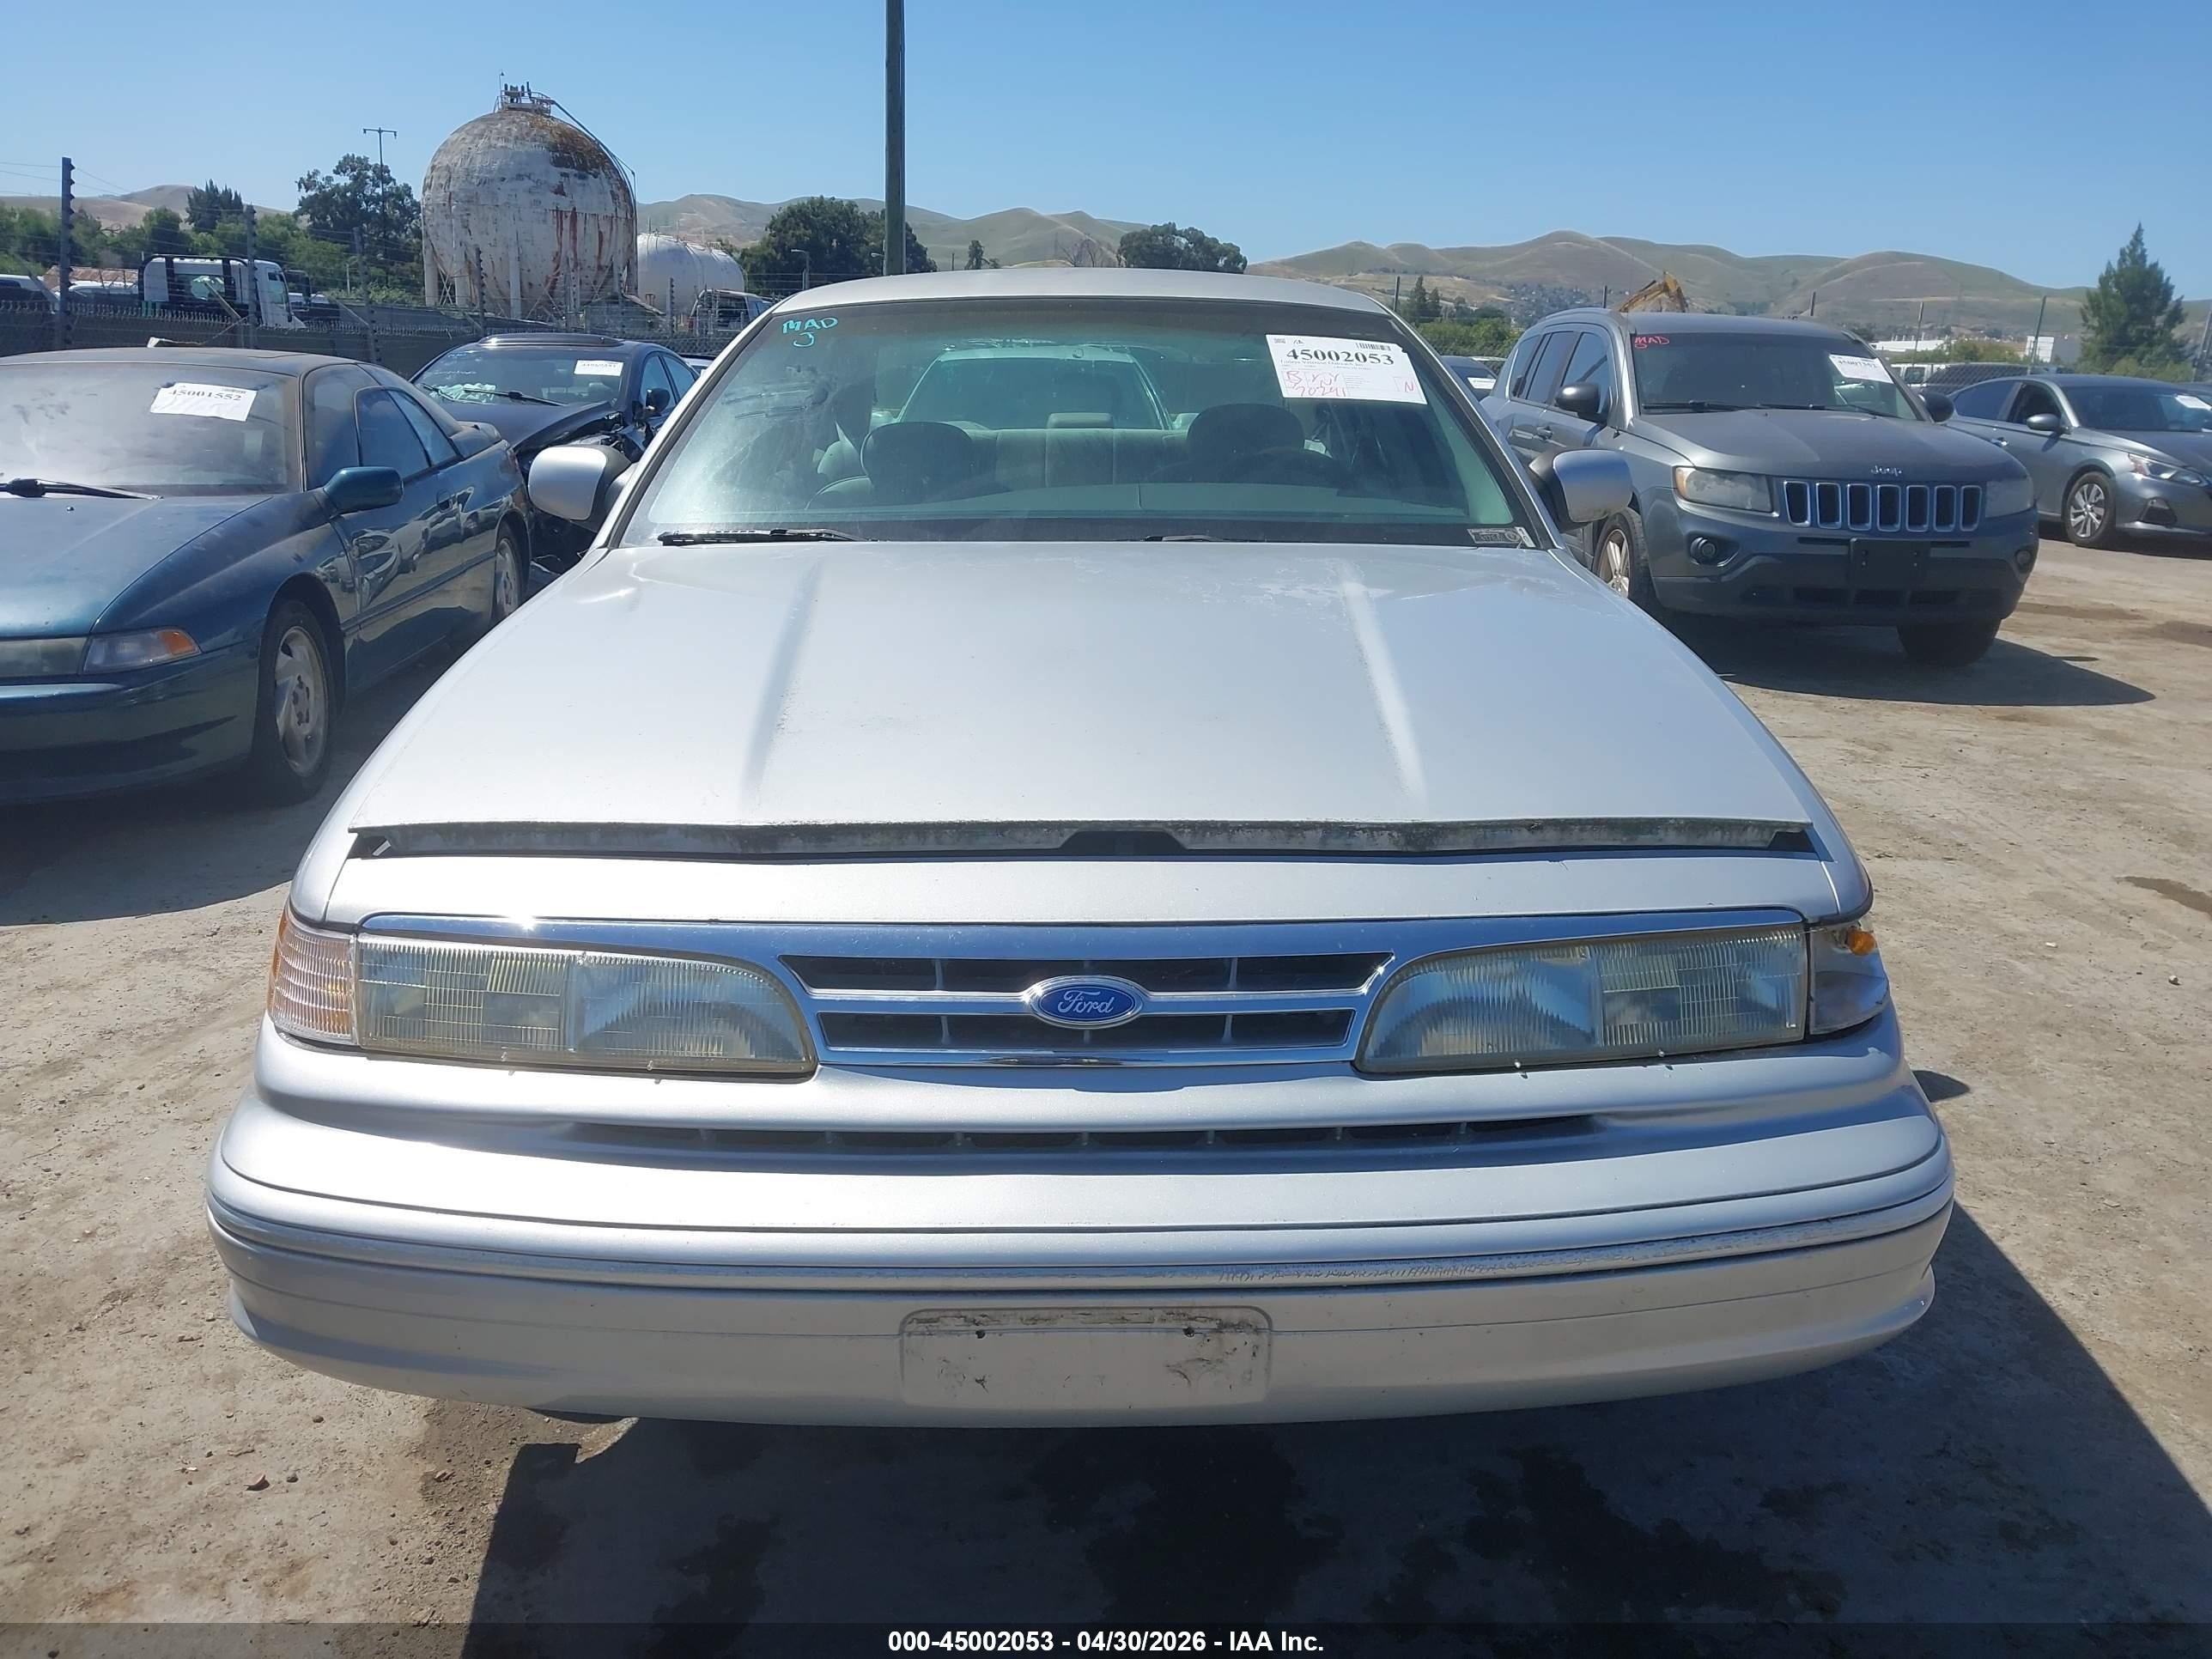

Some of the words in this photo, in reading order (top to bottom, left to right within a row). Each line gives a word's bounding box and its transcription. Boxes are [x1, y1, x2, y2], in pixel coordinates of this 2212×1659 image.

[782, 317, 838, 333] MAD
[1634, 336, 1670, 344] MAD
[1286, 349, 1395, 365] 45002053
[1870, 465, 1902, 477] Jeep
[1057, 990, 1115, 1013] Ford
